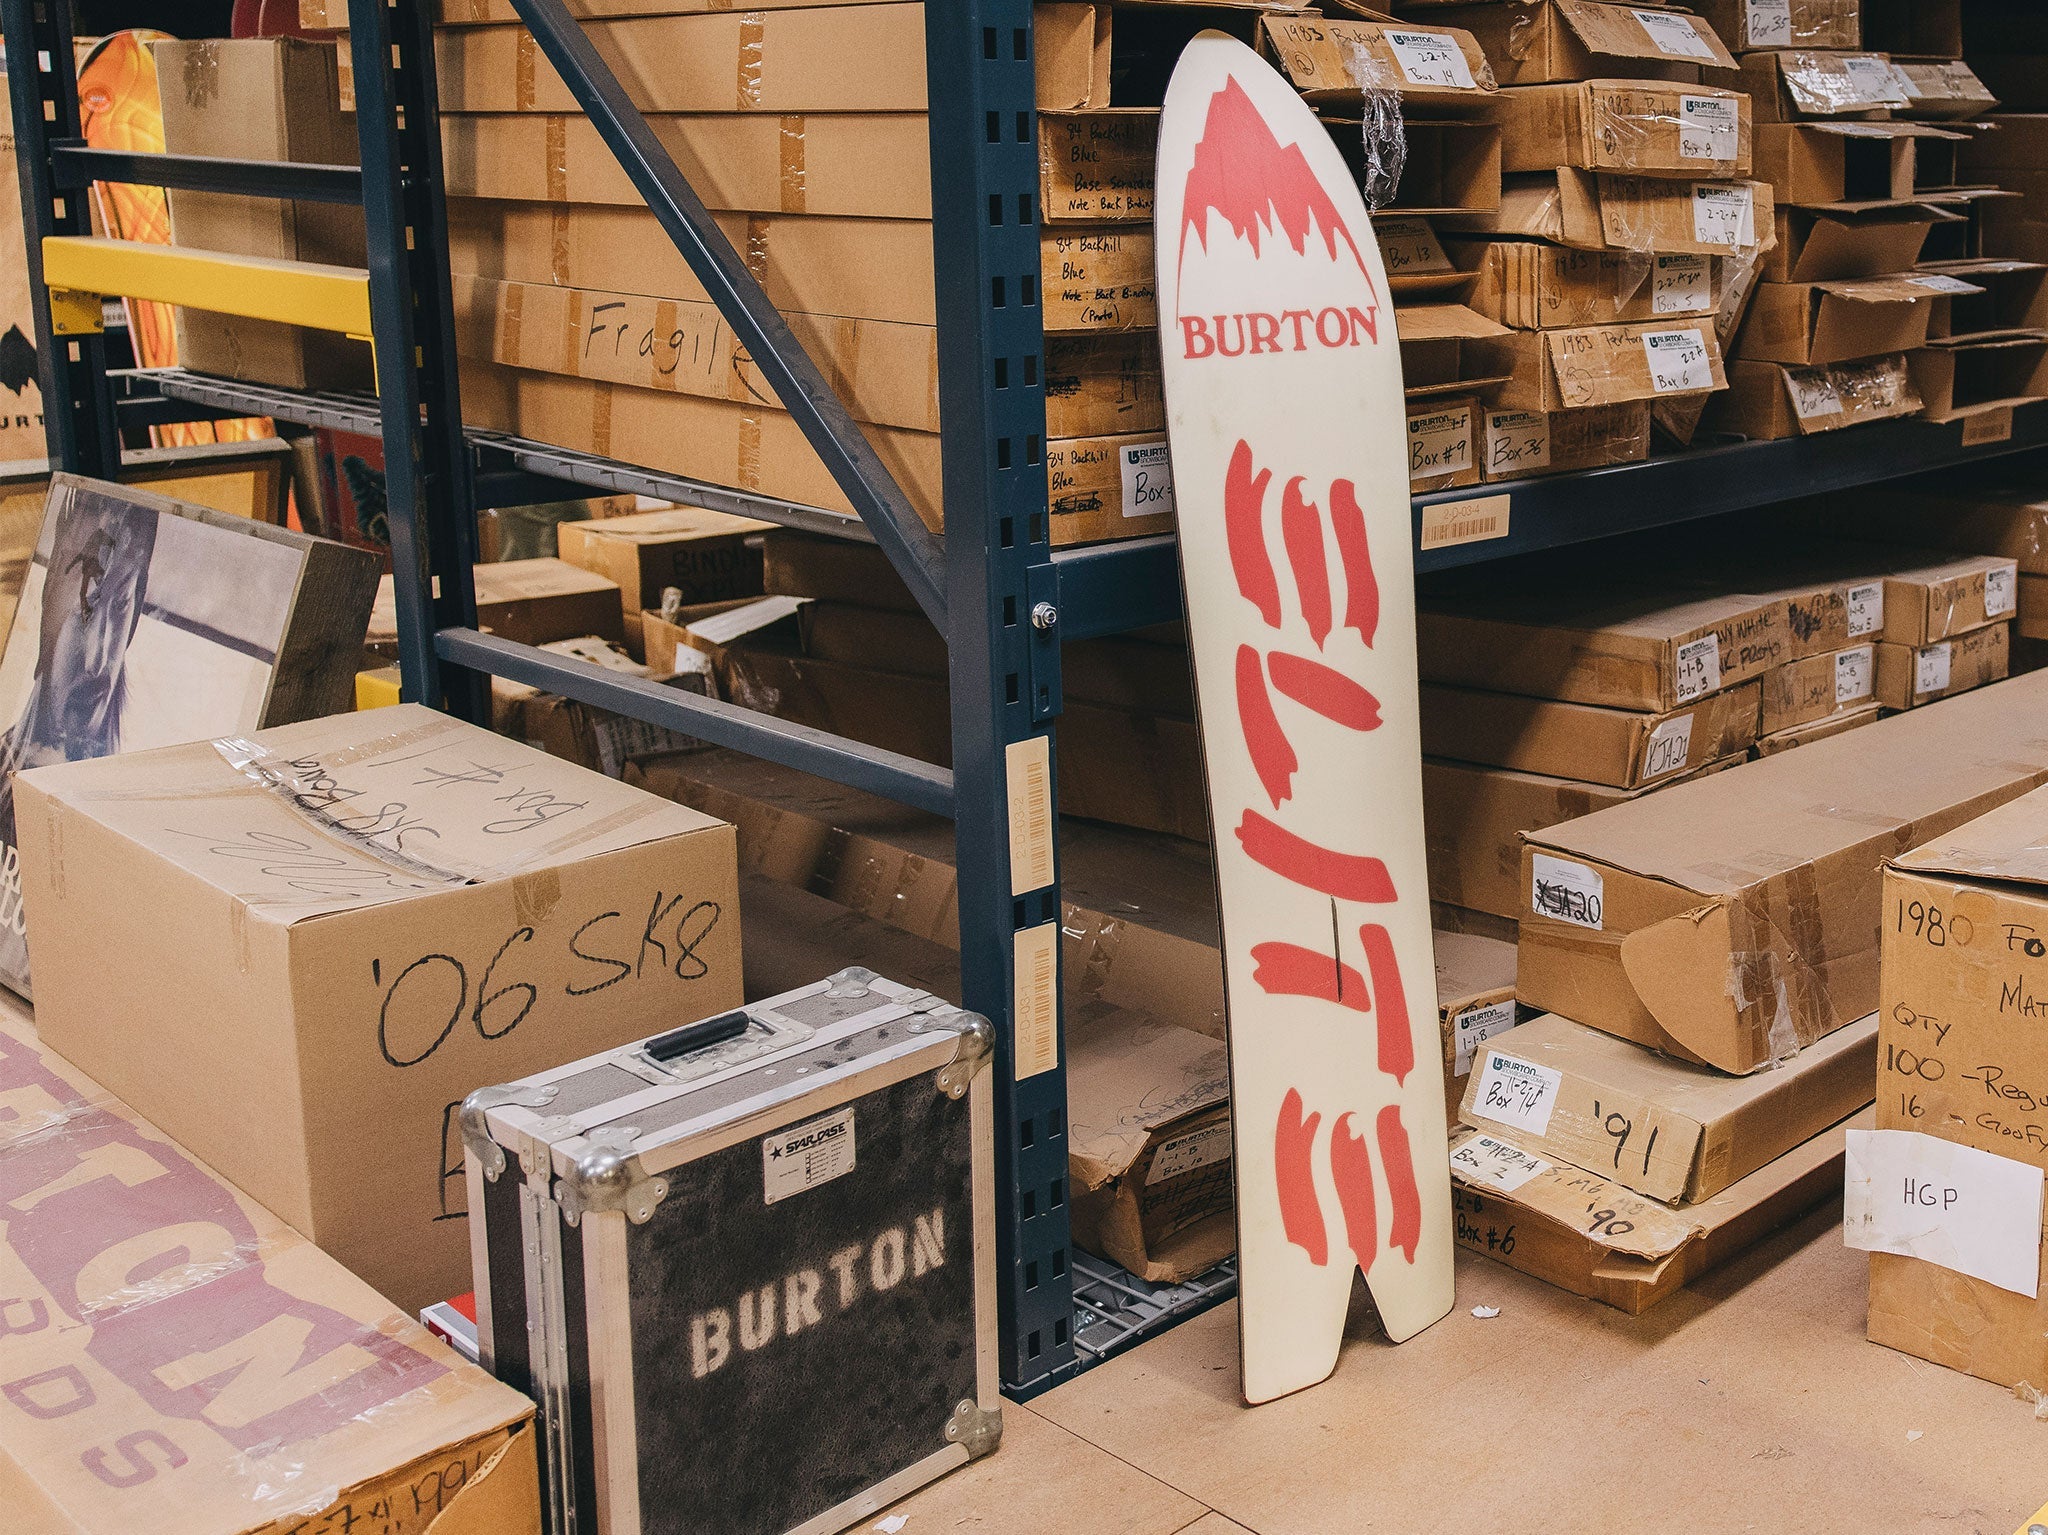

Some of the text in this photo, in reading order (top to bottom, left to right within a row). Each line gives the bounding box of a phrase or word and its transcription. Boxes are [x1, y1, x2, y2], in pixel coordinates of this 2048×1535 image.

[1283, 26, 1324, 42] 1983
[1408, 67, 1457, 86] Box 14
[1071, 145, 1101, 163] Blue
[1683, 140, 1699, 155] Box
[1074, 173, 1102, 192] Base
[1706, 187, 1732, 197] BURTON
[1100, 196, 1121, 209] Back
[1707, 208, 1737, 220] 2-2-A
[1056, 235, 1121, 253] 84 Backhill
[1416, 246, 1430, 261] 13
[1062, 262, 1085, 280] Blue
[1095, 288, 1115, 300] Back
[1179, 306, 1379, 360] BURTON
[1658, 335, 1684, 343] BURTON
[585, 302, 771, 405] Fragile
[1562, 335, 1593, 354] 1983
[1657, 370, 1690, 389] Box 6
[1420, 415, 1449, 427] BURTON
[1501, 413, 1529, 423] BURTON
[1048, 450, 1064, 468] 84
[1140, 447, 1168, 457] BURTO
[1412, 441, 1438, 470] Box
[1493, 436, 1522, 466] Box
[1053, 473, 1076, 490] Blue
[1135, 472, 1164, 506] Box
[1679, 658, 1704, 679] 1-1-B
[1678, 684, 1697, 697] Box
[483, 786, 590, 834] Box
[1225, 438, 1421, 1276] ELITE
[1898, 899, 1974, 947] 1980
[373, 891, 722, 1067] '06 SK8
[1470, 1009, 1497, 1021] BURTON
[1893, 1001, 1952, 1047] QTY
[1503, 1060, 1536, 1076] BURTON
[1887, 1044, 1945, 1081] 100
[1486, 1081, 1512, 1109] Box
[1902, 1094, 1925, 1118] 16
[1177, 1129, 1216, 1144] BURTON
[1594, 1100, 1658, 1176] '91
[1453, 1148, 1480, 1167] Box
[1163, 1165, 1184, 1176] Box
[1904, 1178, 1957, 1210] HGP
[1586, 1202, 1635, 1235] '90
[1457, 1213, 1516, 1255] Box #6
[691, 1208, 945, 1379] BURTON
